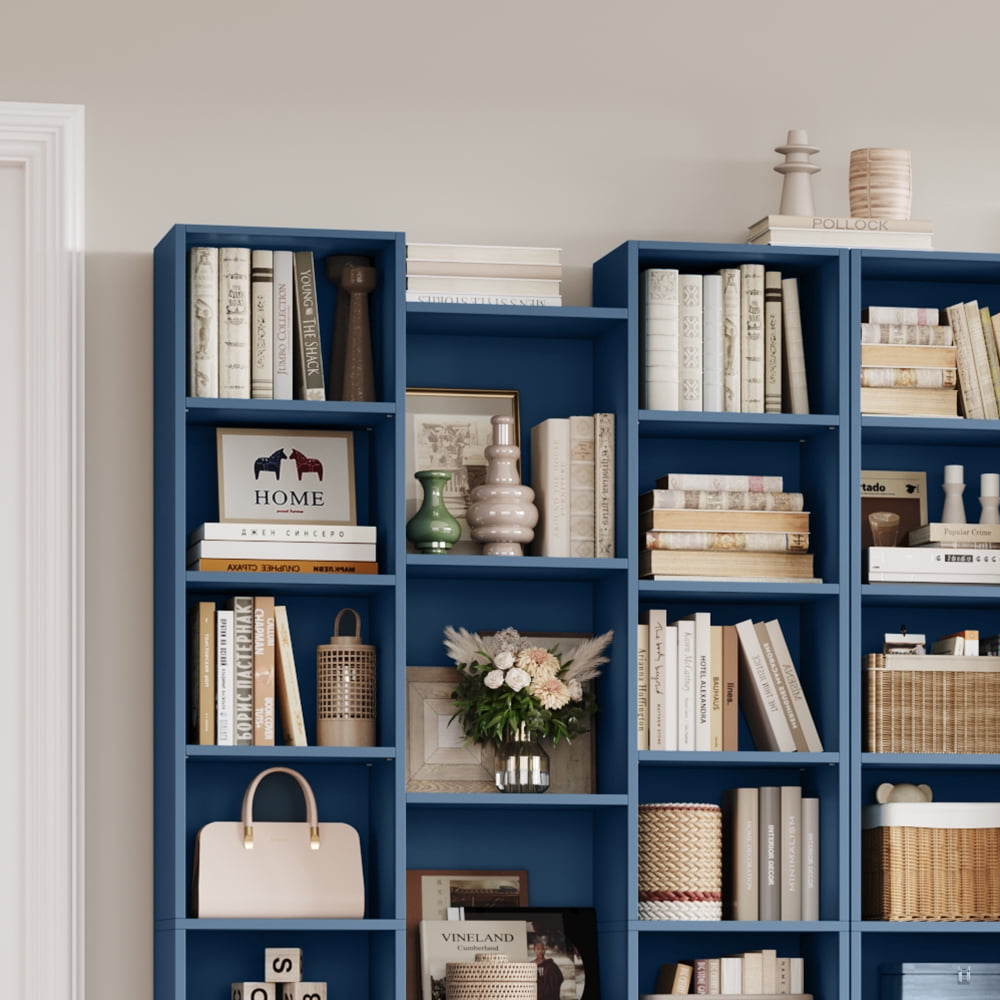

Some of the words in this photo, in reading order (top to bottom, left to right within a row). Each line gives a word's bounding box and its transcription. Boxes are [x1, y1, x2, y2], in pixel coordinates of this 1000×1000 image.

[812, 218, 889, 231] POLLOCK
[300, 269, 313, 308] YOUNG
[277, 283, 288, 341] COLLECTION
[303, 318, 317, 338] THE
[277, 343, 288, 375] JUMBO
[305, 340, 320, 376] SHACK
[254, 490, 325, 506] HOME
[286, 529, 346, 538] СИНСЕРО
[236, 604, 252, 688] ПАСТЕРНАК
[254, 608, 265, 655] CHAPMAN
[638, 648, 648, 682] Arianna
[712, 676, 720, 710] BAUHAUS
[727, 682, 735, 705] lines.
[236, 693, 252, 740] БОРИС
[788, 816, 796, 892] MINIMALISM
[442, 933, 514, 943] VINELAND
